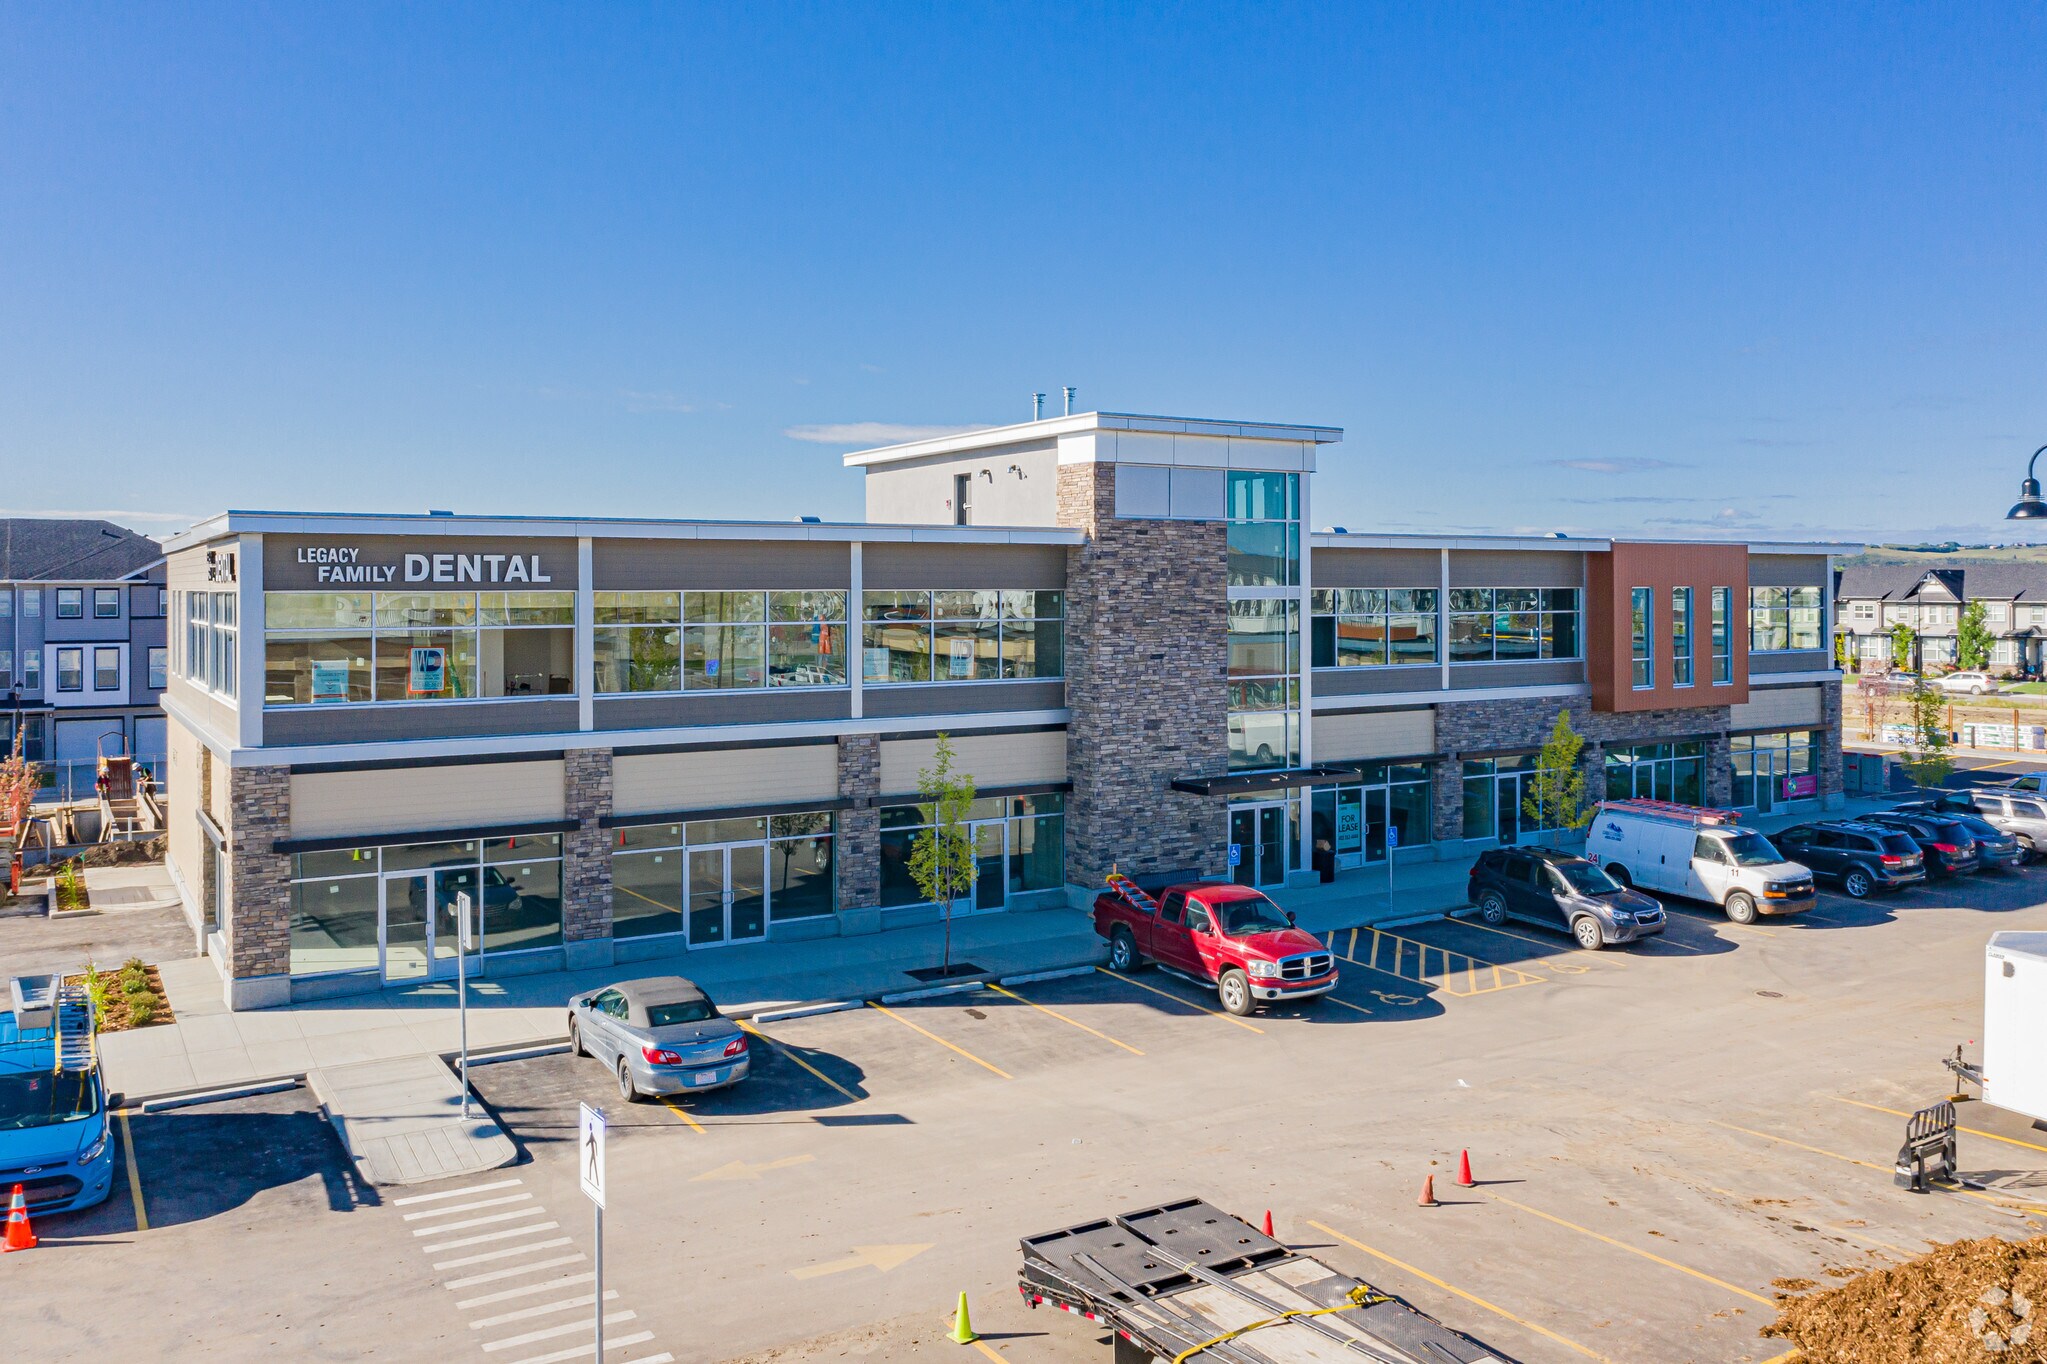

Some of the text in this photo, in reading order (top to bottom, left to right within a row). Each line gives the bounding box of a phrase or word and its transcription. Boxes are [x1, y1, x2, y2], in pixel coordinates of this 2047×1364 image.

[297, 547, 359, 563] LEGACY
[318, 565, 397, 583] FAMILY
[404, 553, 551, 583] DENTAL
[1338, 823, 1358, 832] LEASE
[1588, 852, 1598, 863] 24
[1731, 868, 1739, 877] 11
